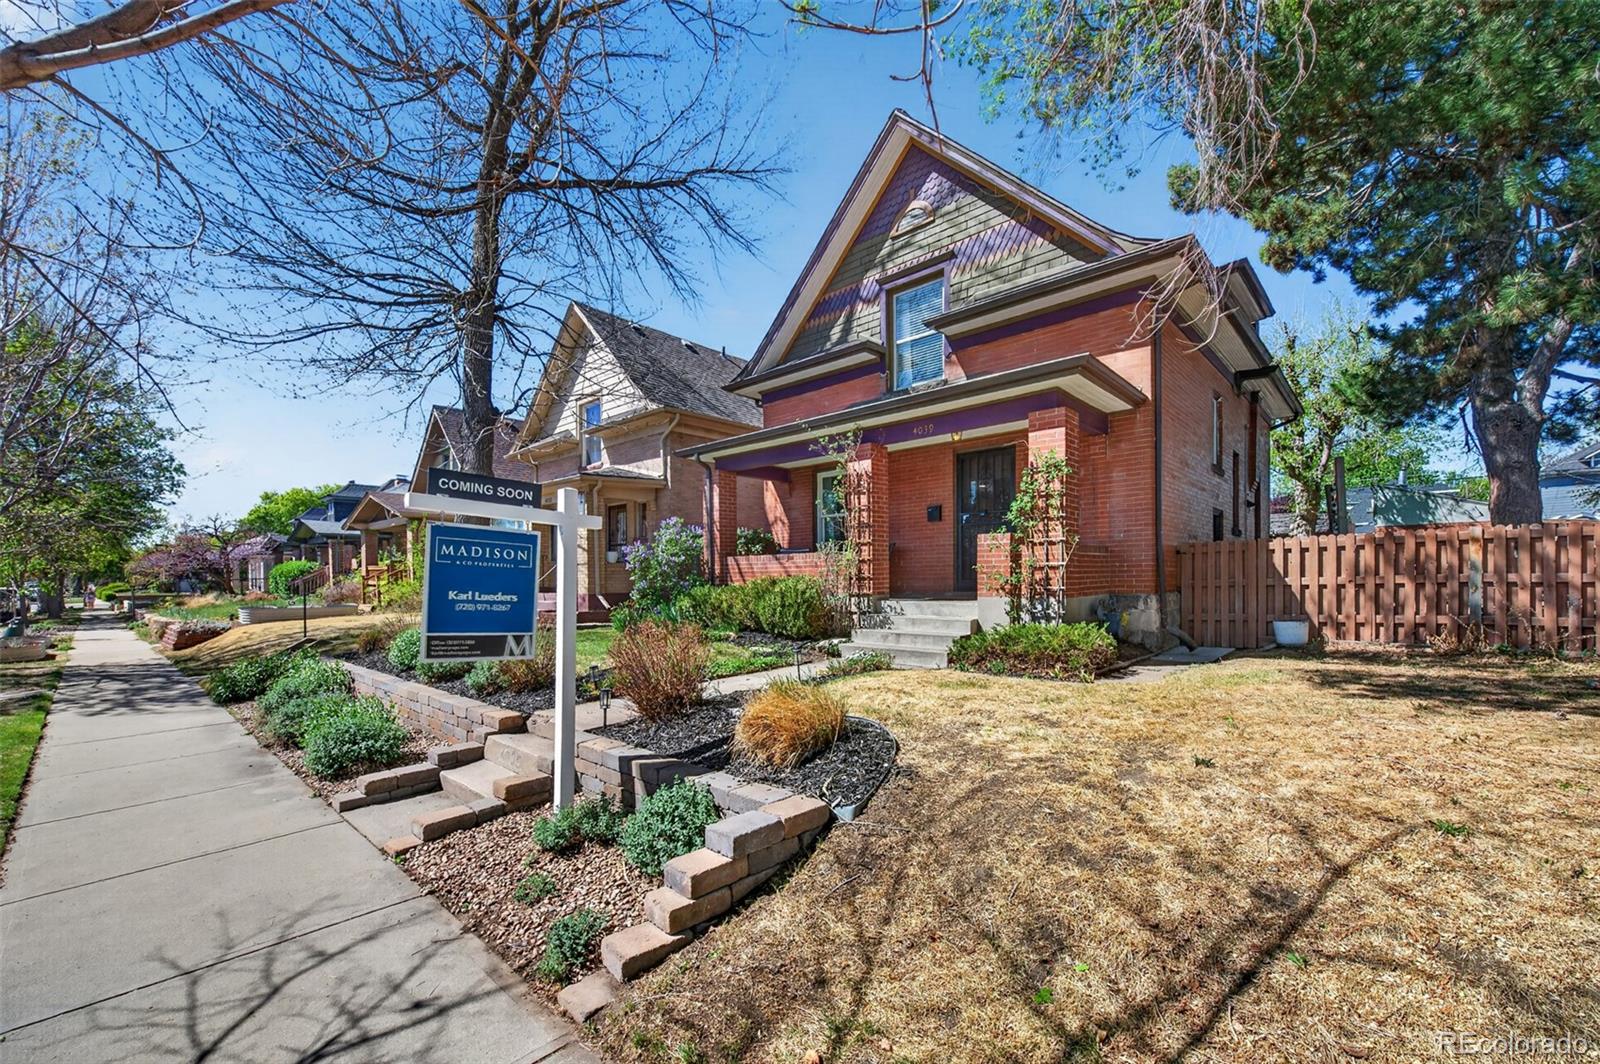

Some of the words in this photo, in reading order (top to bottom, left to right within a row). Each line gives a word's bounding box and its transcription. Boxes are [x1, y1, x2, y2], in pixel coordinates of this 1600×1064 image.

[438, 478, 494, 495] COMING
[496, 486, 533, 501] SOON
[440, 544, 528, 560] MADISON
[448, 590, 473, 600] Karl
[474, 591, 518, 602] Lueders
[503, 634, 534, 657] M
